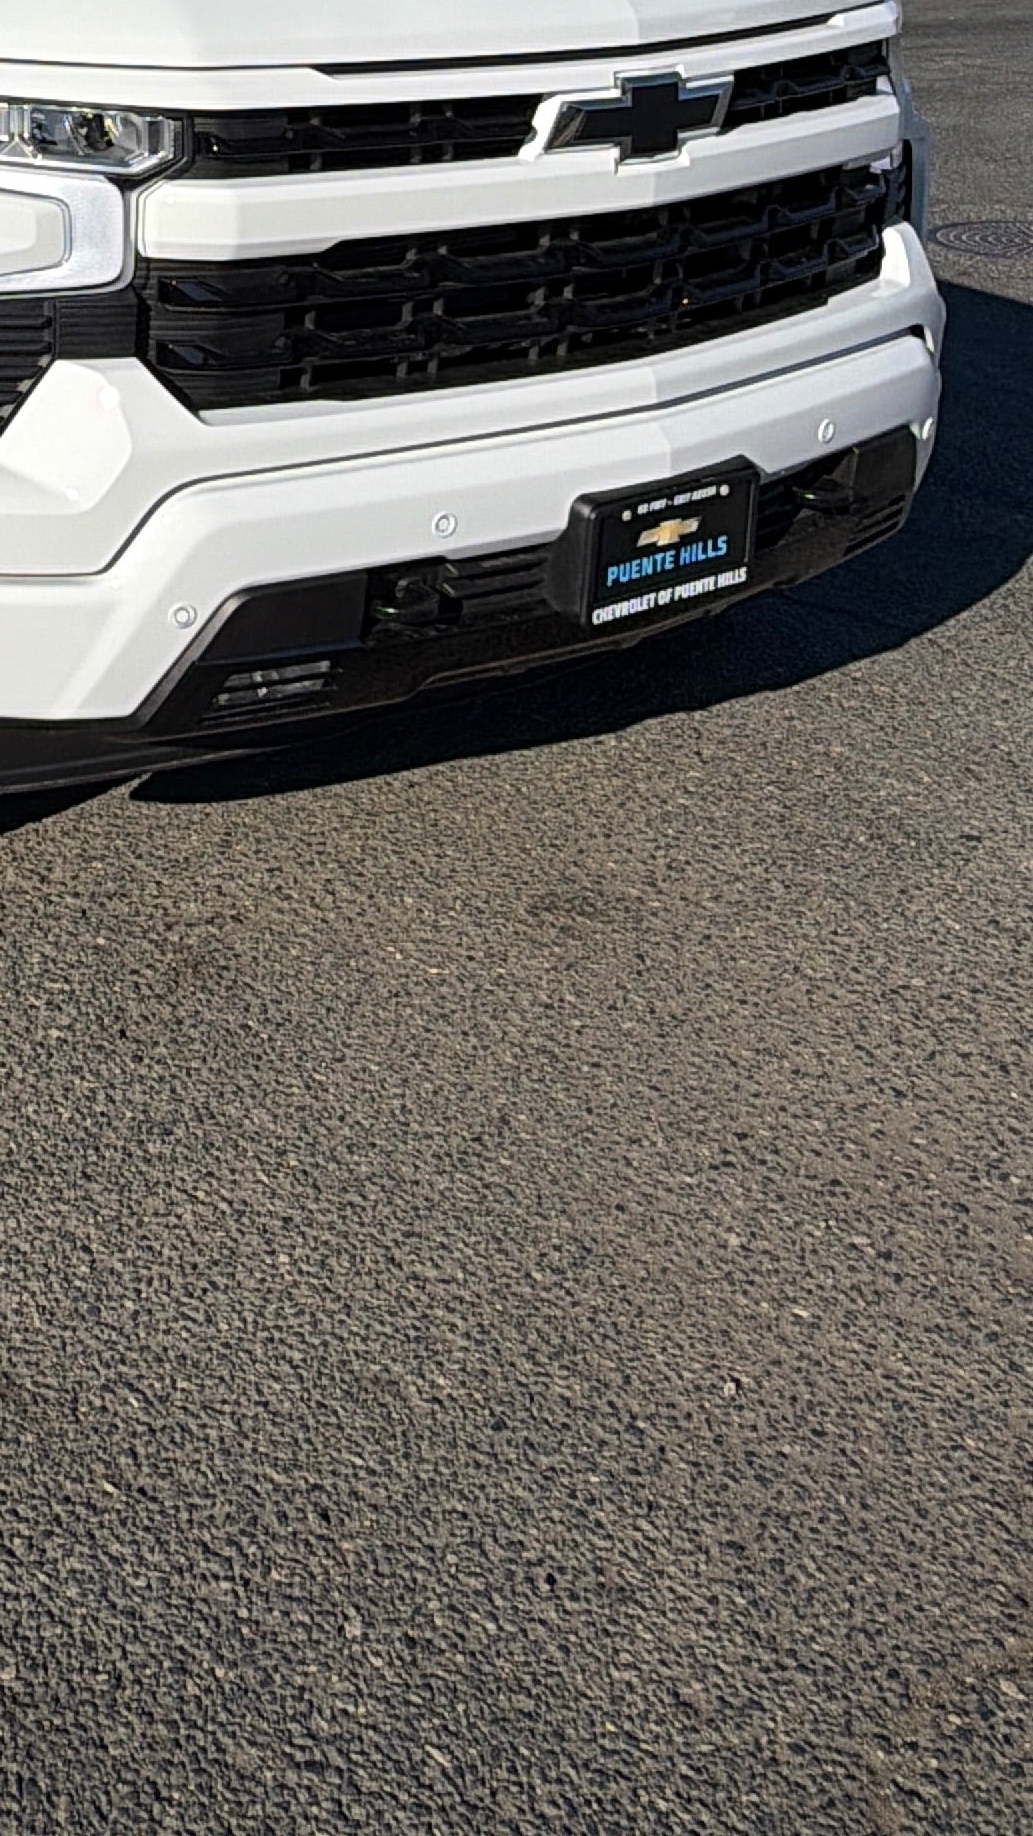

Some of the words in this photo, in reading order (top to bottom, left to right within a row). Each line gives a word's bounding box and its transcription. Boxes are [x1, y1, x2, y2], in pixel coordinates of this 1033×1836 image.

[606, 550, 676, 587] PUENTE
[679, 535, 729, 565] HILLS
[592, 592, 656, 625] CHEVROLET
[657, 588, 673, 606] OF
[674, 575, 717, 602] PUENTE
[717, 566, 748, 588] HILLS
